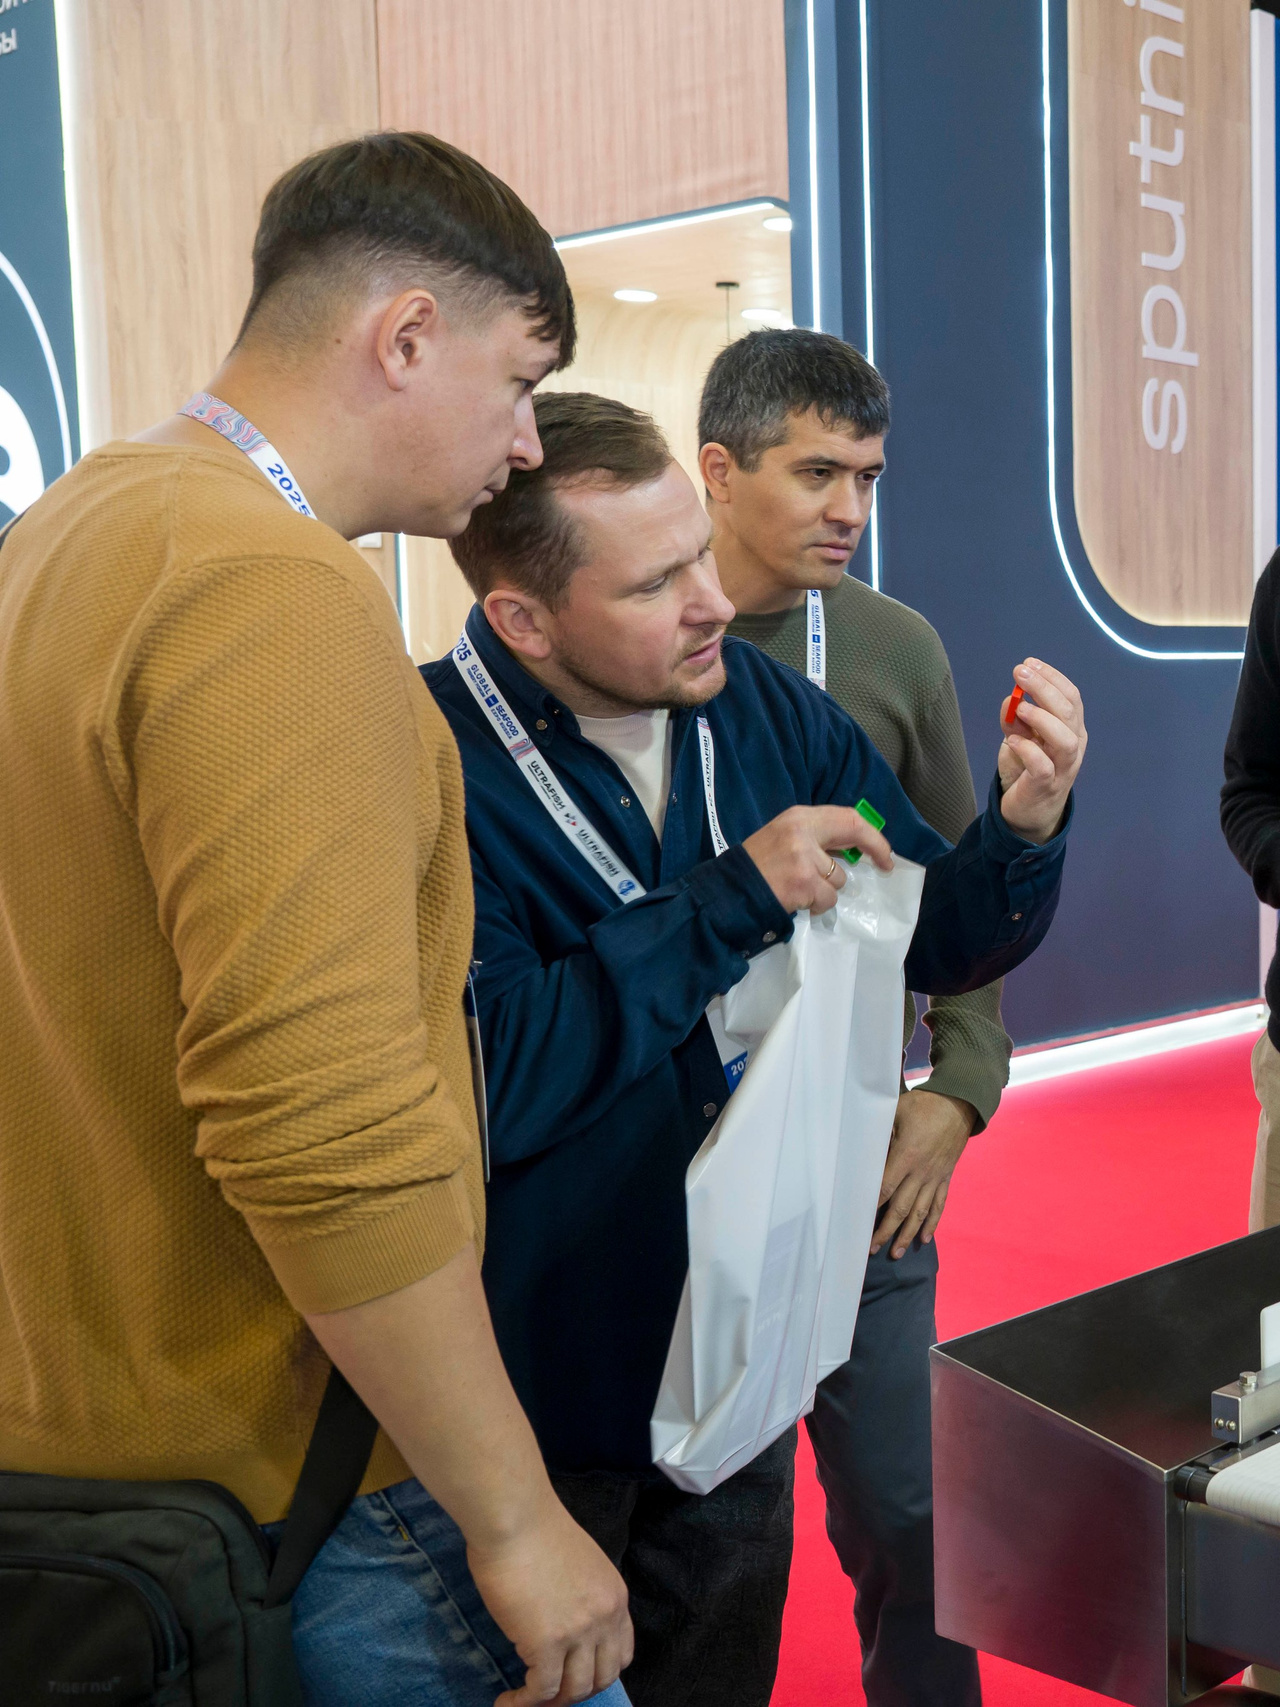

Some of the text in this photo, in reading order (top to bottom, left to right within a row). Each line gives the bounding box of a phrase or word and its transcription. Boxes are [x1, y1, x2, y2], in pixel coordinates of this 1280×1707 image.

[470, 664, 492, 695] GLOBAL
[495, 704, 519, 737] SEAFOOD
[530, 760, 565, 810] ULTRAFISH
[703, 735, 711, 787] ULTRAFISH
[578, 829, 621, 877] ULTRAFISH
